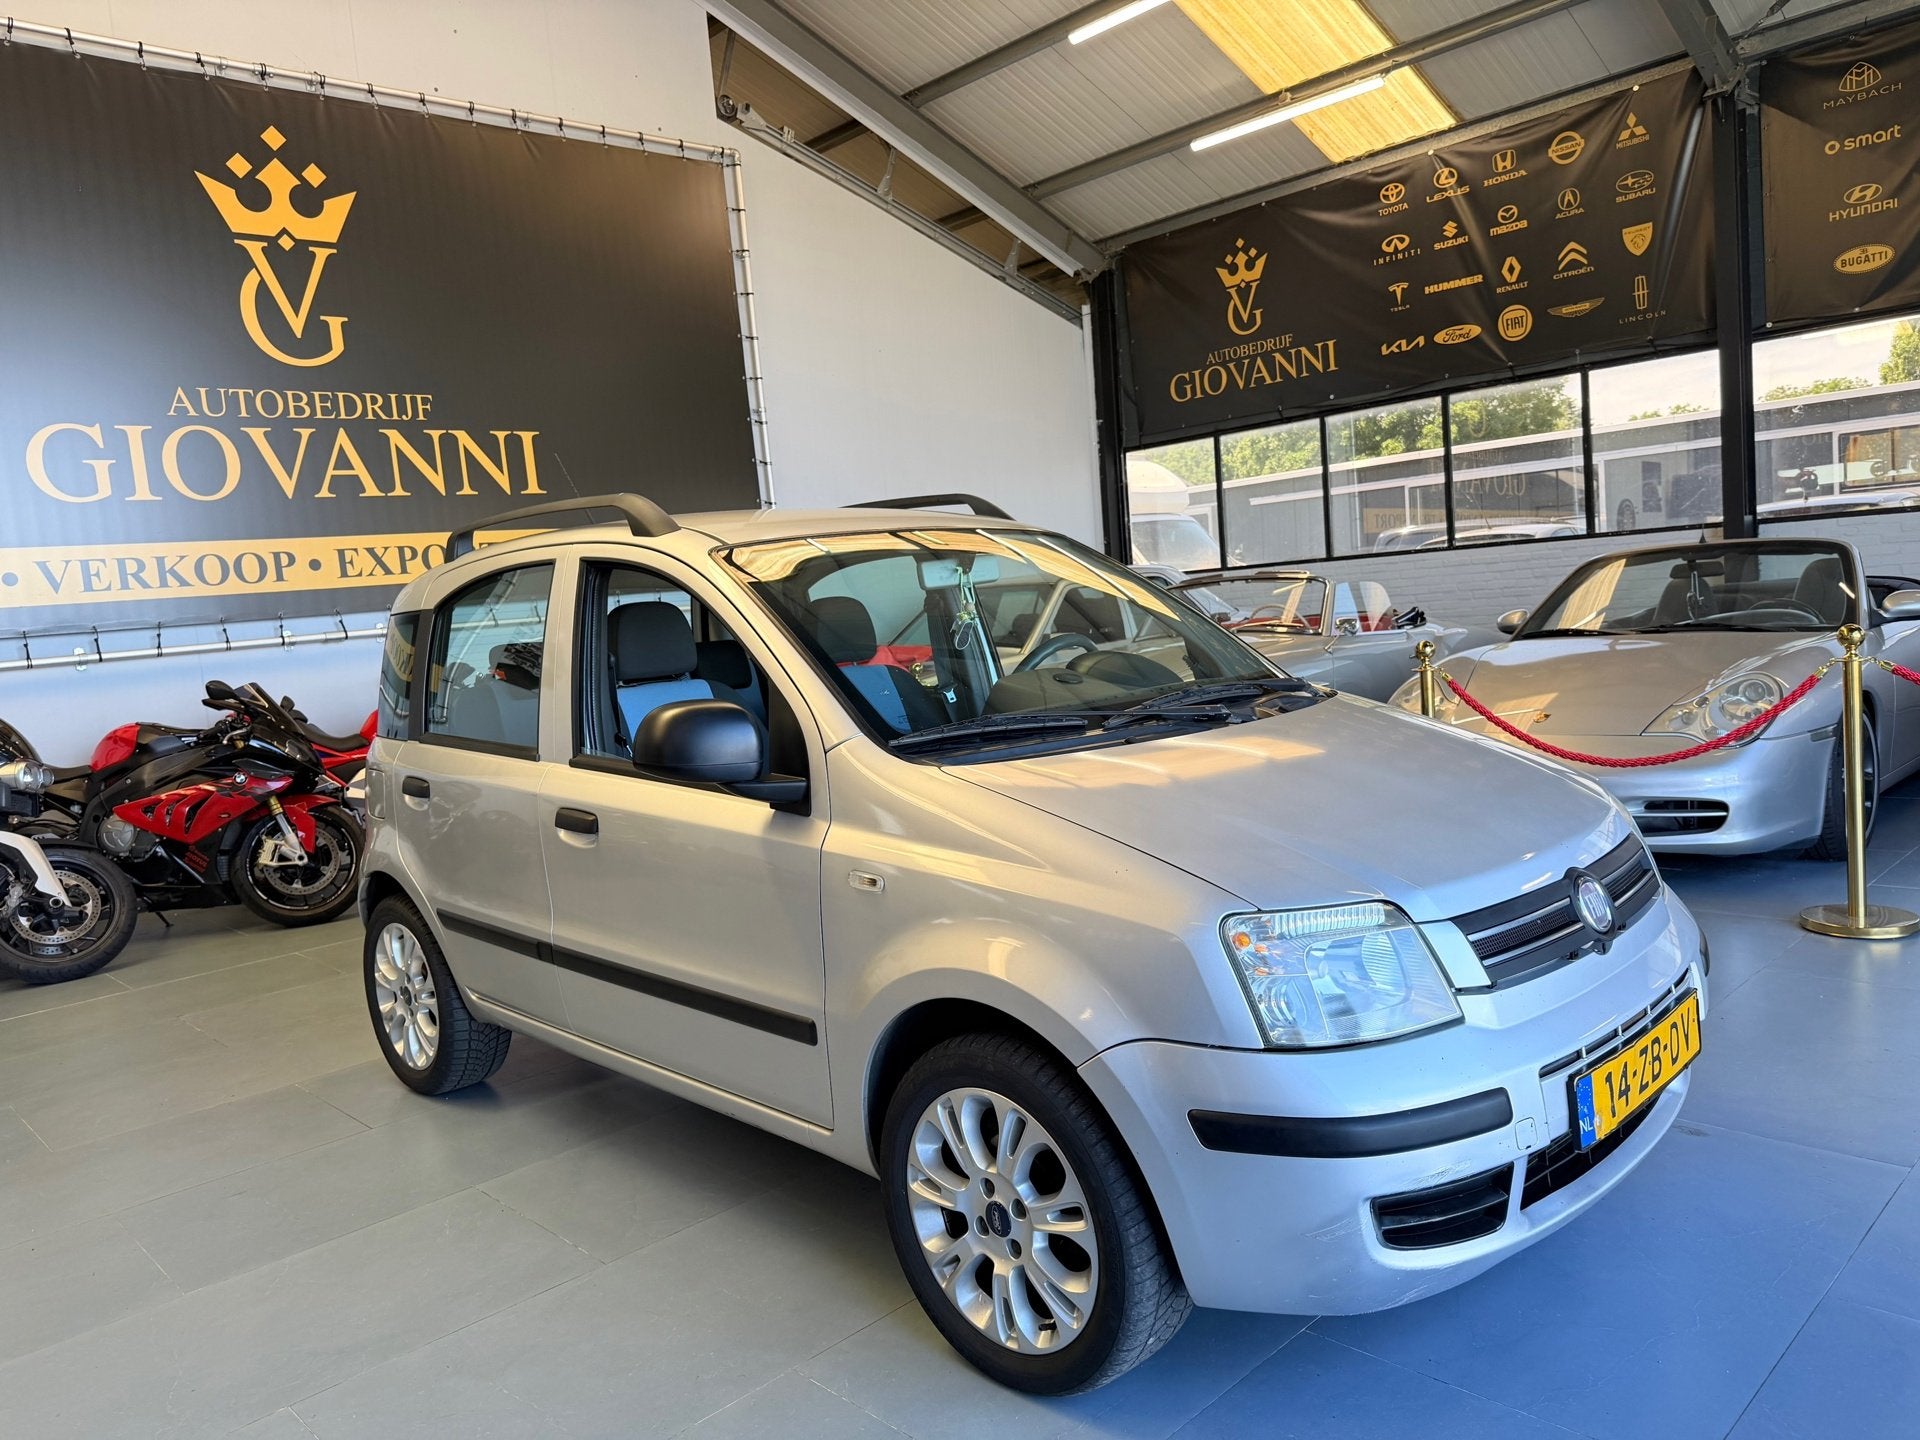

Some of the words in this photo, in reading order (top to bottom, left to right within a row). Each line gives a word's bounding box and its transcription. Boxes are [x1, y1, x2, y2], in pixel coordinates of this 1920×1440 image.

[1823, 82, 1902, 110] MAYBACH
[1616, 134, 1650, 149] MITSUBISHI
[1844, 124, 1901, 150] smart
[1551, 140, 1582, 154] NISSAN
[1483, 169, 1528, 187] HONDA
[1426, 185, 1470, 203] LEXUS
[1616, 187, 1656, 203] SUBARU
[1378, 203, 1409, 217] TOYOTA
[1555, 208, 1585, 220] ACURA
[1829, 198, 1898, 222] HYUNDAI
[1433, 235, 1469, 250] SUZUKI
[1373, 248, 1421, 266] INFINITI
[1840, 251, 1888, 269] BUGATTI
[1424, 274, 1484, 295] HUMMER
[1496, 281, 1529, 294] RENAULT
[1505, 315, 1525, 332] FIAT
[1619, 309, 1667, 325] LINCOLN
[1442, 327, 1472, 343] Ford
[1206, 333, 1293, 365] AUTOBEDRIJF
[1169, 339, 1340, 403] GIOVANNI
[167, 386, 433, 421] AUTOBEDRIJF
[25, 422, 548, 503] GIOVANNI
[33, 550, 298, 595] VERKOOP
[335, 541, 505, 579] EXPO
[1604, 1006, 1690, 1119] 14-ZB-DV
[1579, 1118, 1594, 1135] NL
